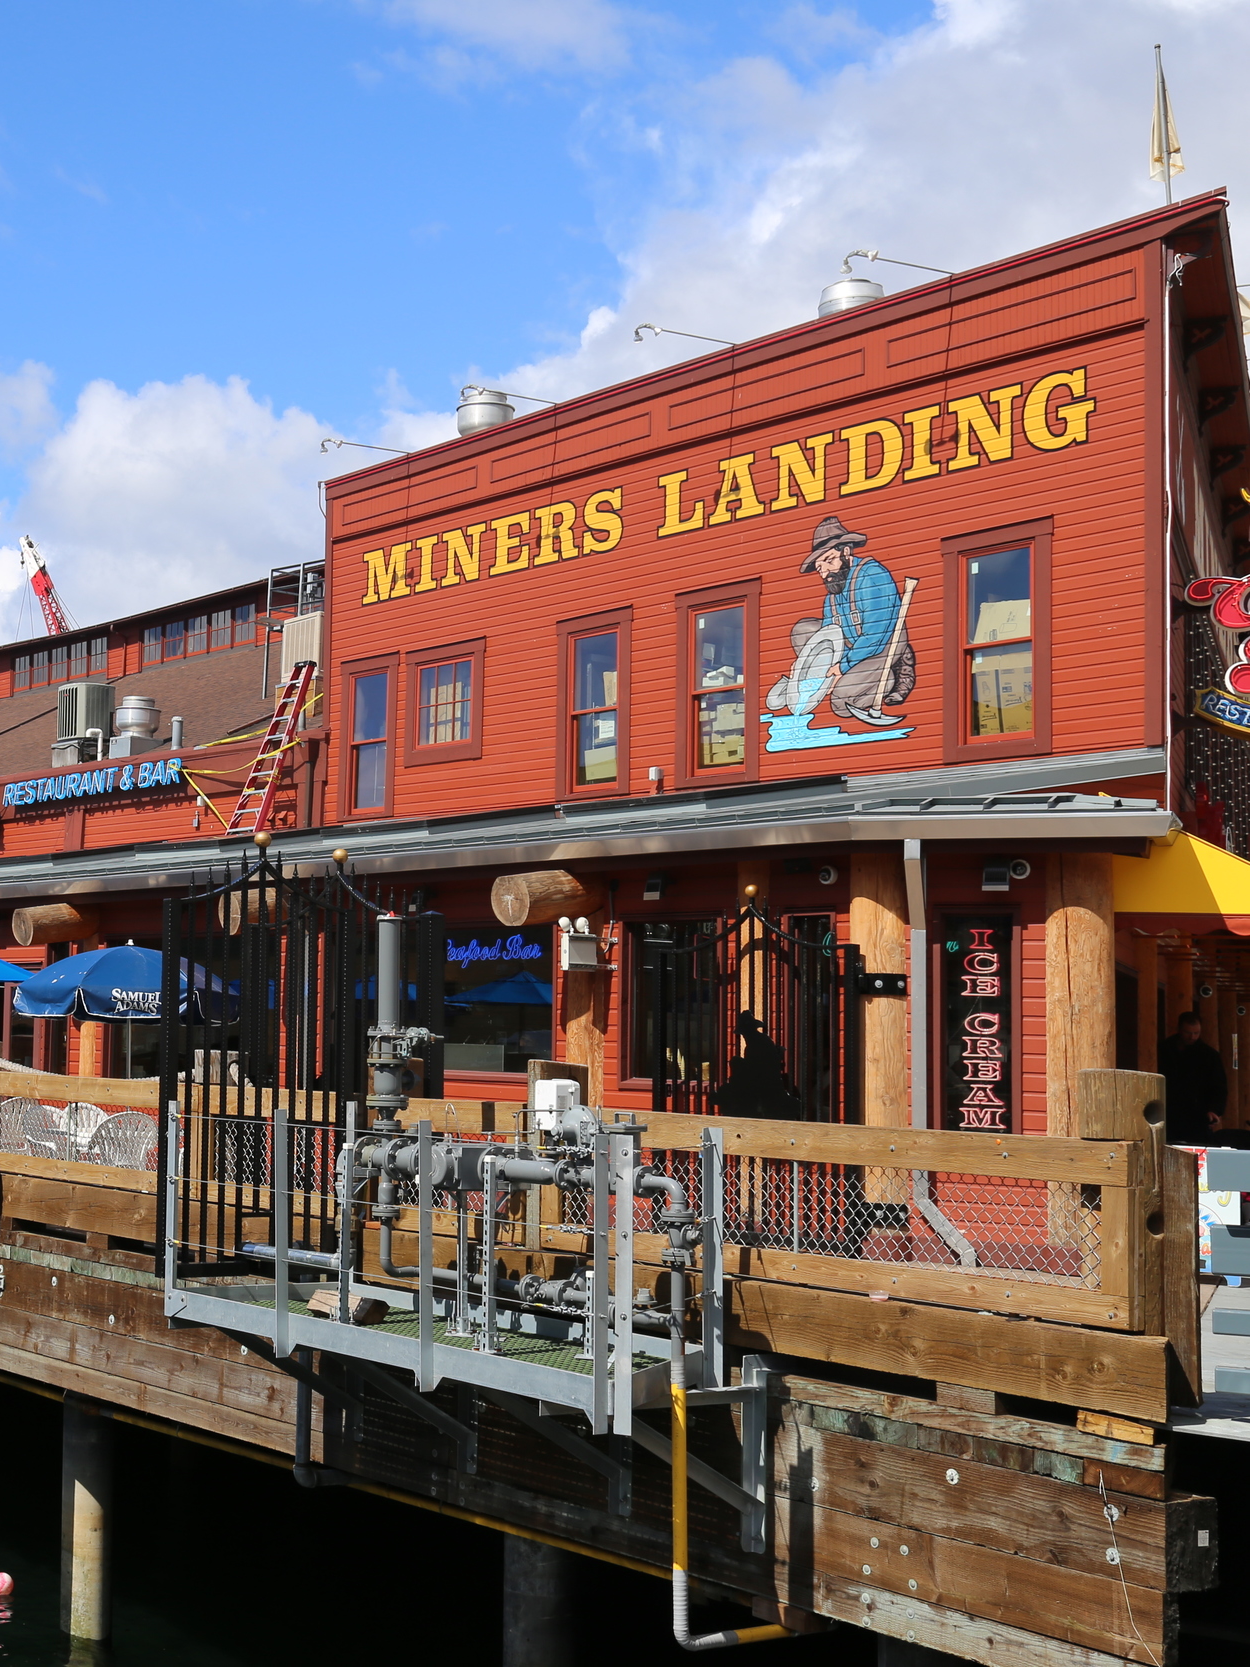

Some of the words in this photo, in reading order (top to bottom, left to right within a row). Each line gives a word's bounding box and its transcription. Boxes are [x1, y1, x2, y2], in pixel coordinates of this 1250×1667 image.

[361, 485, 624, 606] MINERS
[656, 366, 1097, 539] LANDING
[2, 766, 119, 807] RESTAURANT
[119, 764, 136, 791] &
[137, 757, 182, 789] BAR
[502, 933, 542, 960] Bar
[960, 929, 1000, 997] ICE
[111, 987, 162, 1005] SAMUEL
[113, 1000, 158, 1016] ADAMS
[958, 1012, 1007, 1129] CREAM
